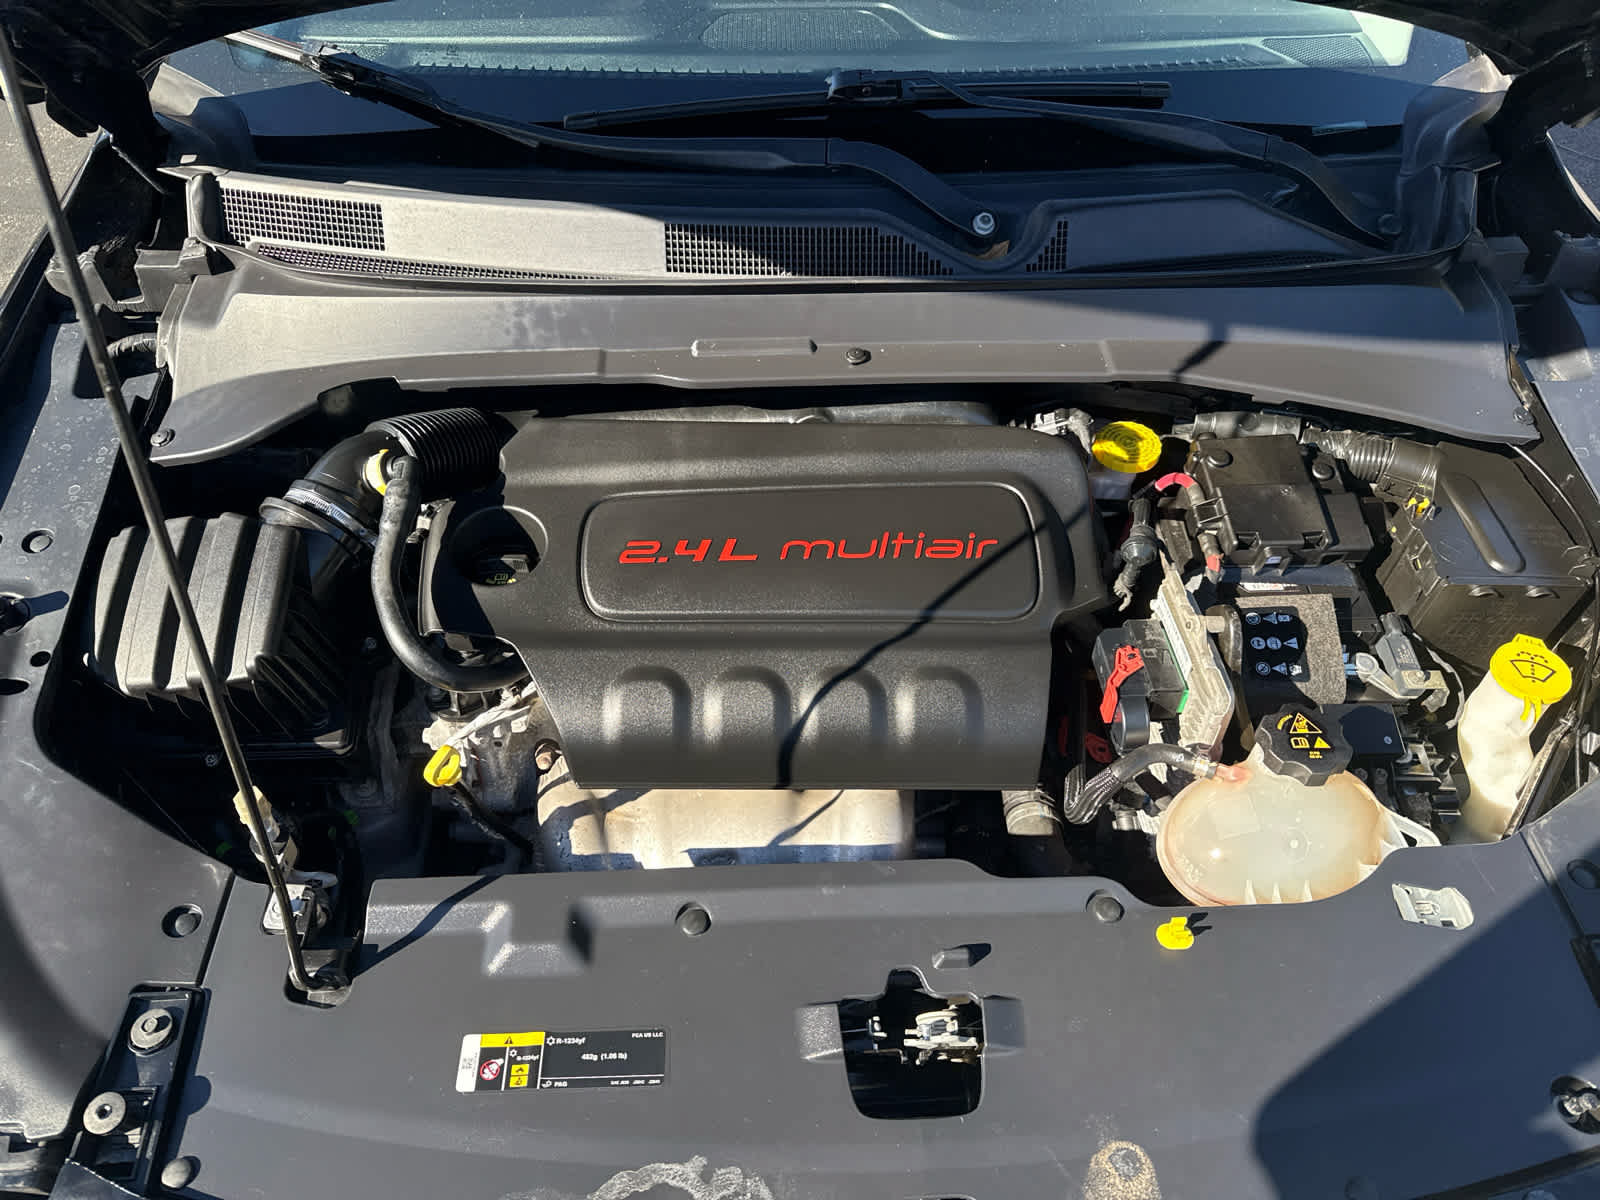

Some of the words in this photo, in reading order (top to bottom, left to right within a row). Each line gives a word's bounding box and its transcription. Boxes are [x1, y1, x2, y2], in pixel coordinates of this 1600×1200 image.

[619, 537, 758, 564] 2.4L
[779, 531, 998, 560] multiair
[556, 1037, 586, 1045] R-1234yf
